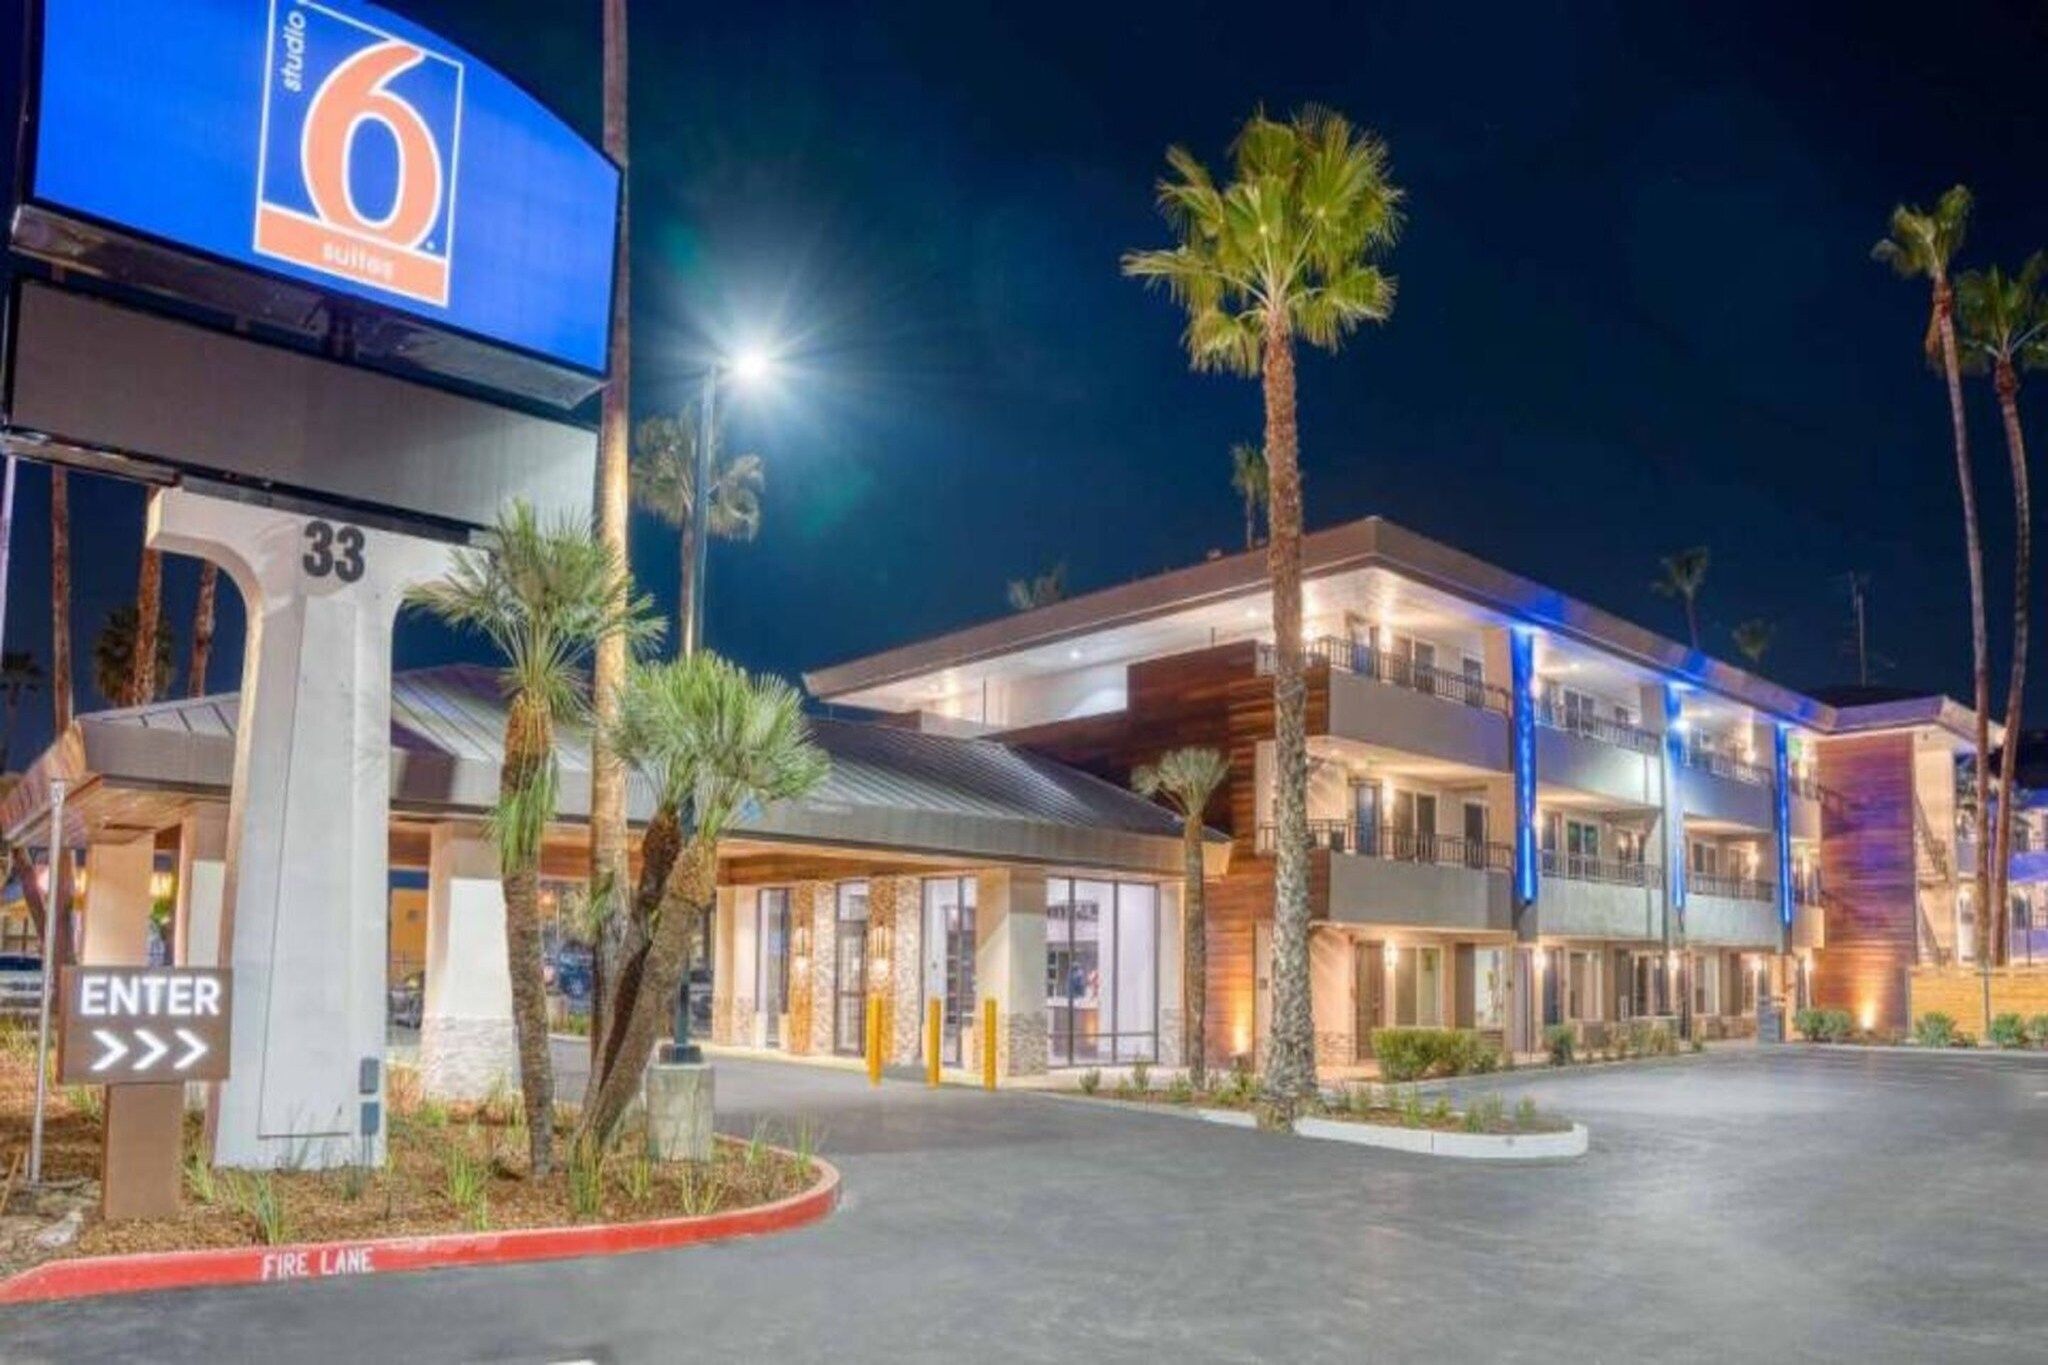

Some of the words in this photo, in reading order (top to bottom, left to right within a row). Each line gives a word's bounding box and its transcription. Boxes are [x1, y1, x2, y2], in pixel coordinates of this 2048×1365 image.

[281, 10, 306, 92] studio
[301, 39, 442, 250] 6
[303, 520, 365, 583] 33
[80, 974, 221, 1016] ENTER
[262, 1252, 309, 1281] FIRE
[320, 1247, 376, 1275] LANE
